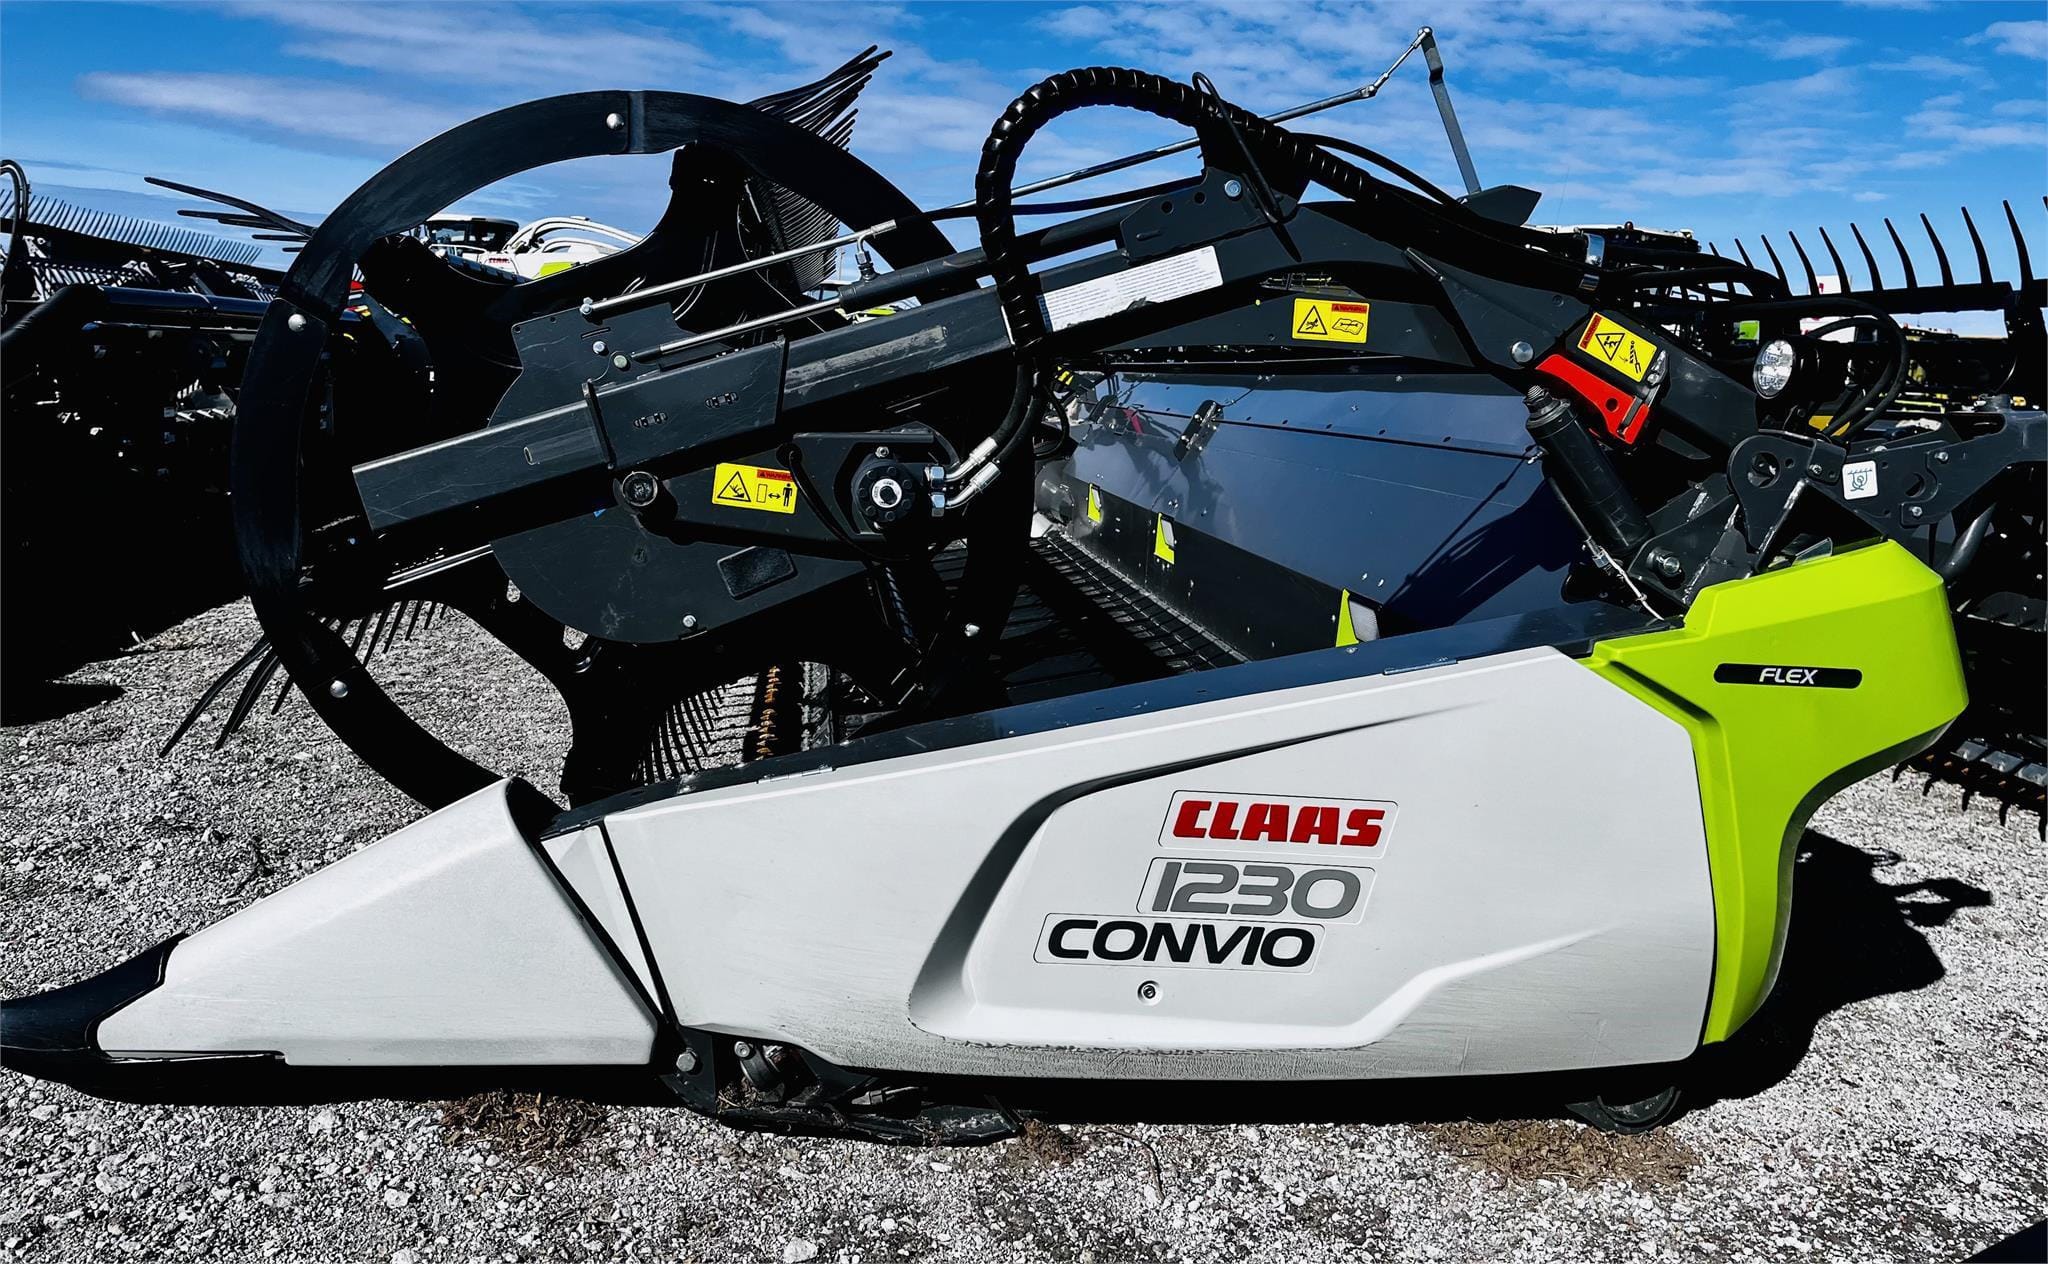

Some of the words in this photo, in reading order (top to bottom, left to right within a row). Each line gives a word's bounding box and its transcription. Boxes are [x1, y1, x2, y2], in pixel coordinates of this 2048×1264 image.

[1759, 668, 1818, 685] FLEX
[1173, 800, 1386, 847] CLAAS
[1152, 862, 1361, 919] 1230
[1048, 919, 1316, 967] CONVIO
